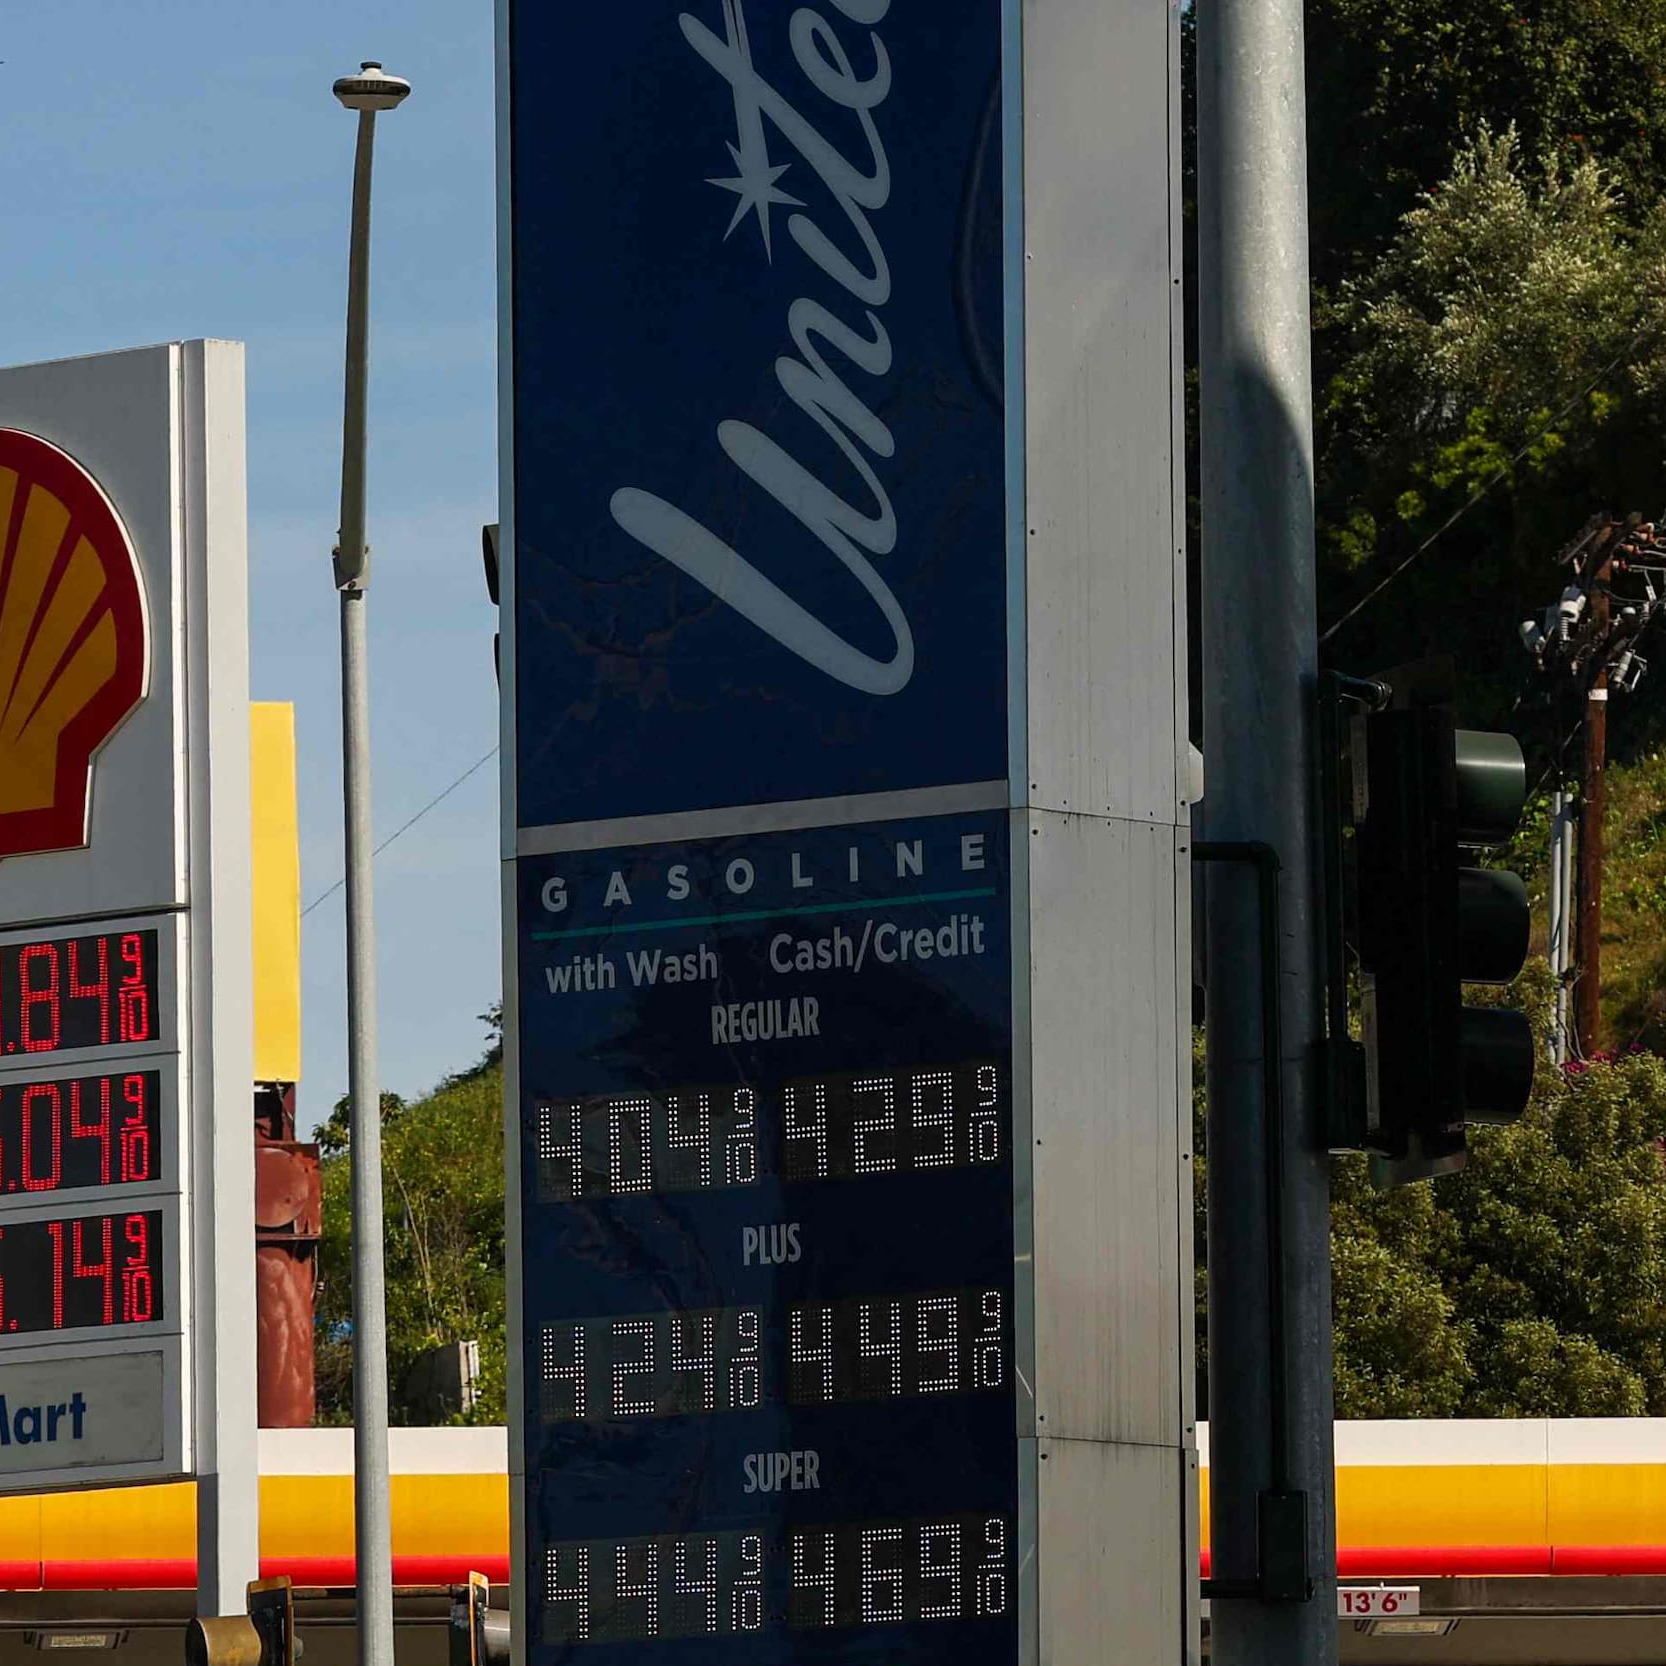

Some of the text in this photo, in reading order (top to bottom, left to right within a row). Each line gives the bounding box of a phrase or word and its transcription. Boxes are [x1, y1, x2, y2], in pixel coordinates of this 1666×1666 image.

[609, 0, 915, 697] Unite
[541, 834, 985, 912] GASOLINE
[545, 914, 985, 993] with Wash Cash/Credit
[711, 997, 820, 1044] REGULAR
[742, 1223, 802, 1266] PLUS
[743, 1450, 820, 1493] SUPER
